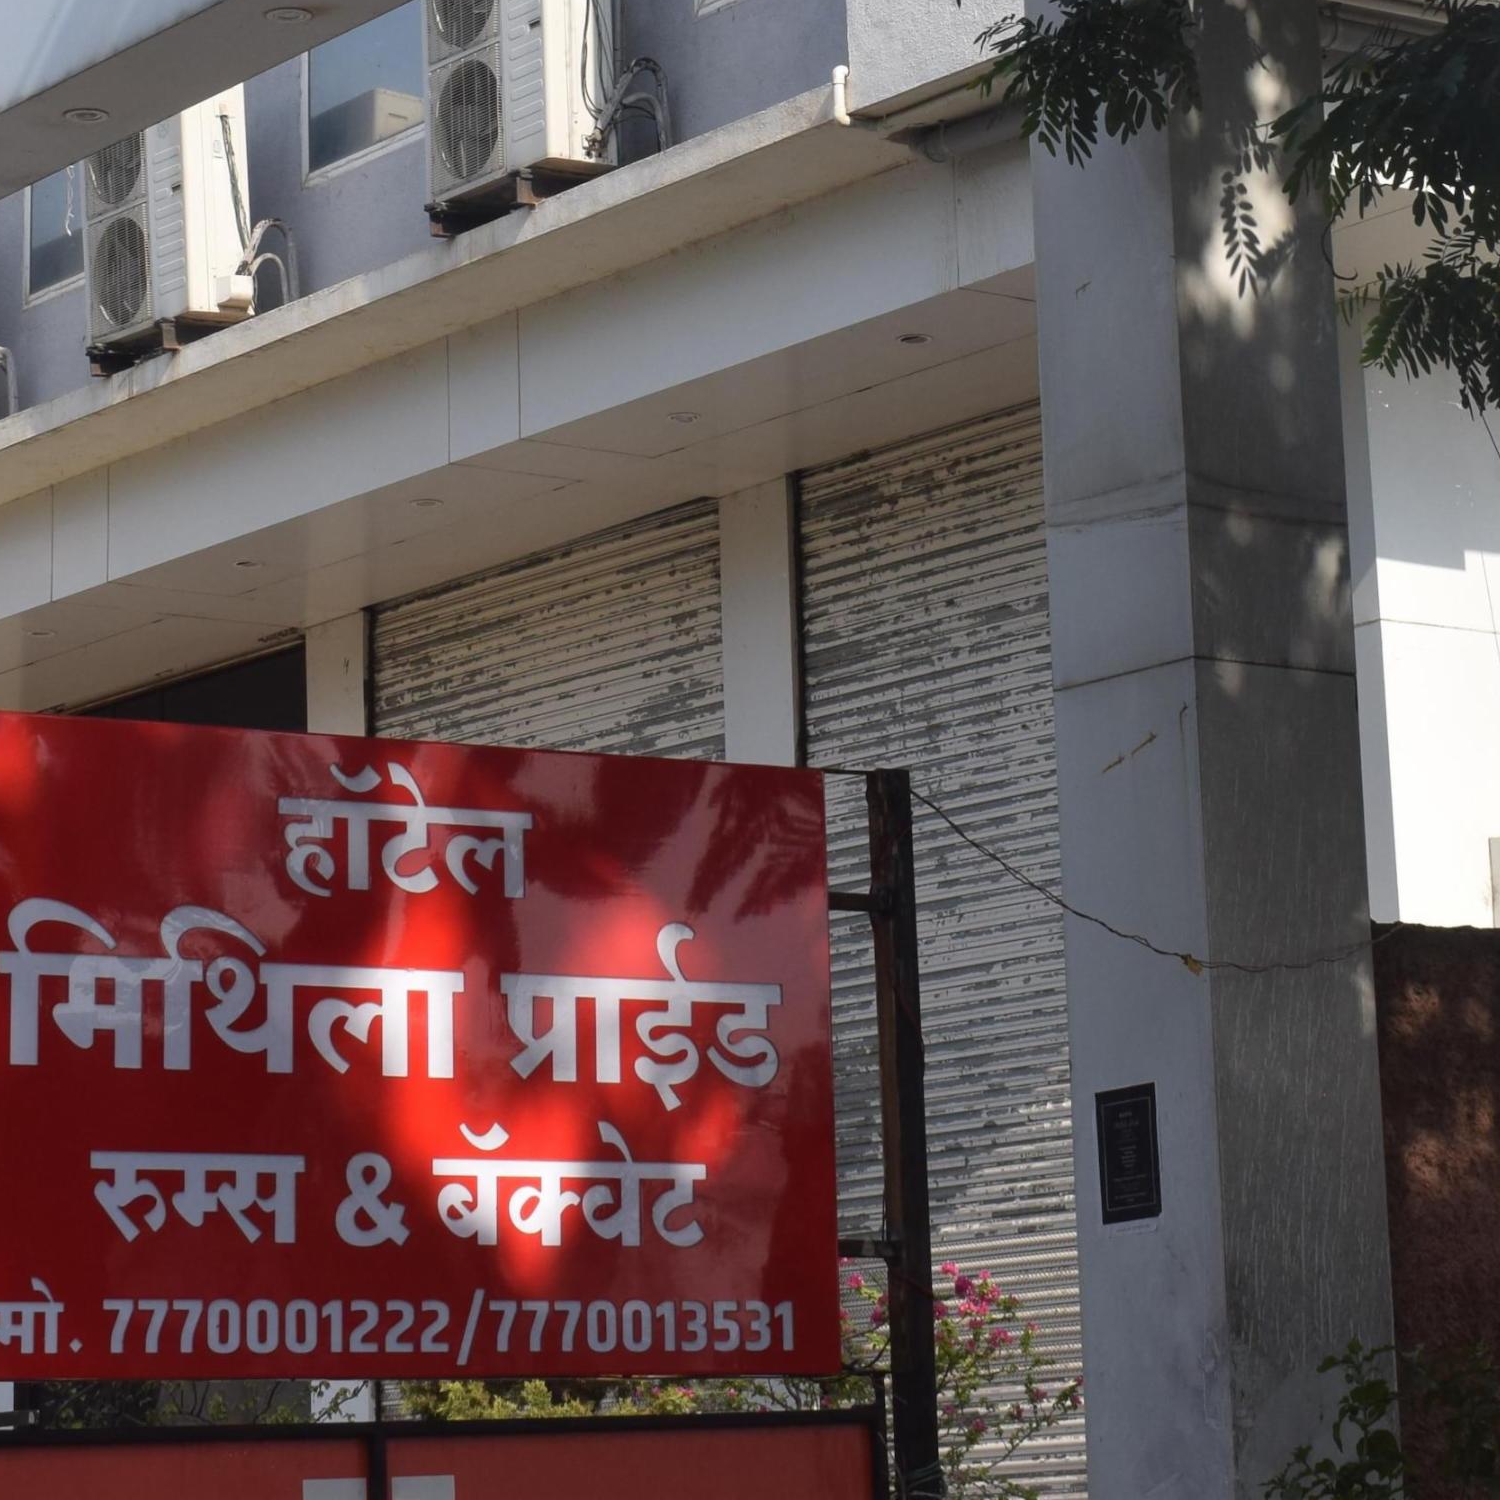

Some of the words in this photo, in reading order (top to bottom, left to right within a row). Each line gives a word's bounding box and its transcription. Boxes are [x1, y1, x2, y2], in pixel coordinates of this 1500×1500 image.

[279, 763, 531, 898] हॉटेल
[500, 922, 782, 1111] प्राईड
[90, 1151, 305, 1243] रुम्स
[335, 1152, 409, 1247] &
[103, 1290, 794, 1365] 7770001222/7770013531
